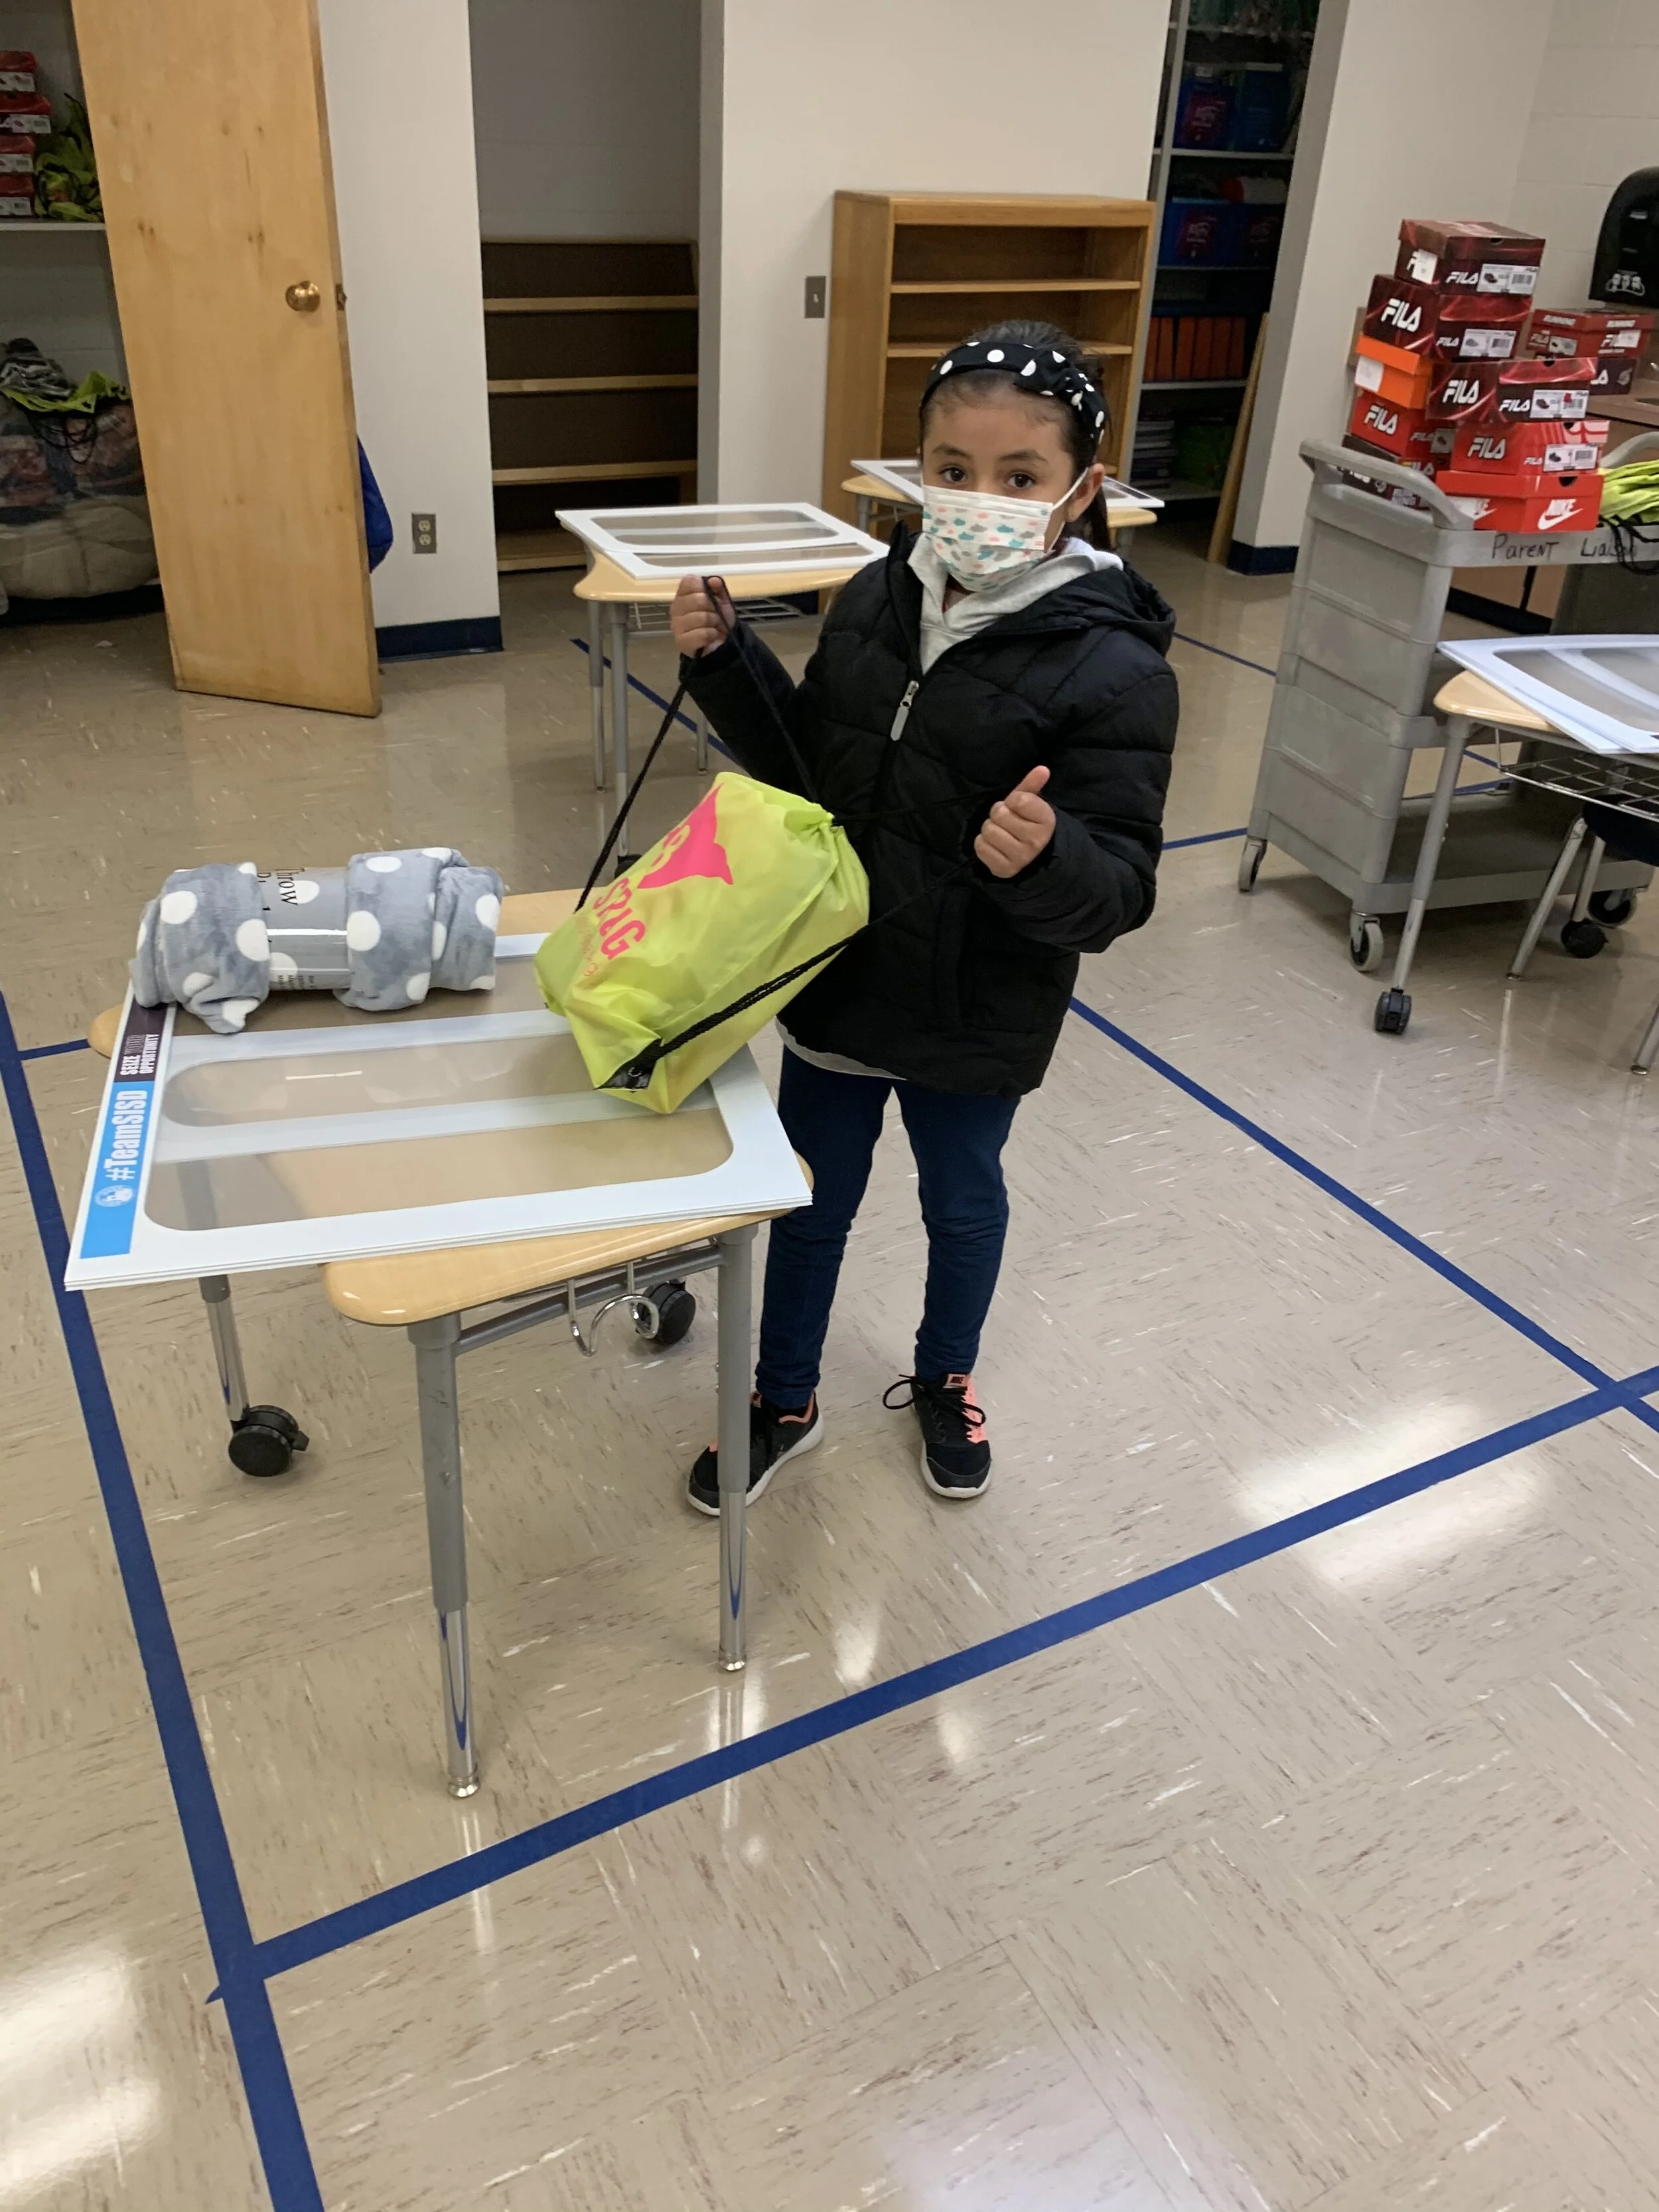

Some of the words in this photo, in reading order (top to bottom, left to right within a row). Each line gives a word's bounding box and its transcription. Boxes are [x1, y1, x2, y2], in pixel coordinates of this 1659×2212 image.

[1446, 271, 1479, 285] FILA
[1380, 297, 1422, 332] FILA
[1435, 337, 1459, 348] FILA
[1442, 380, 1480, 404] FILA
[1499, 399, 1531, 412] FILA
[1364, 405, 1398, 435] FILA
[1467, 437, 1506, 459] FILA
[1524, 457, 1543, 465] FILA
[1546, 498, 1577, 516] NIKE
[275, 867, 305, 906] Throw
[139, 1033, 160, 1074] OPPORTUNITY
[119, 1054, 141, 1076] SEIZE
[104, 1090, 148, 1182] #TeamSISD
